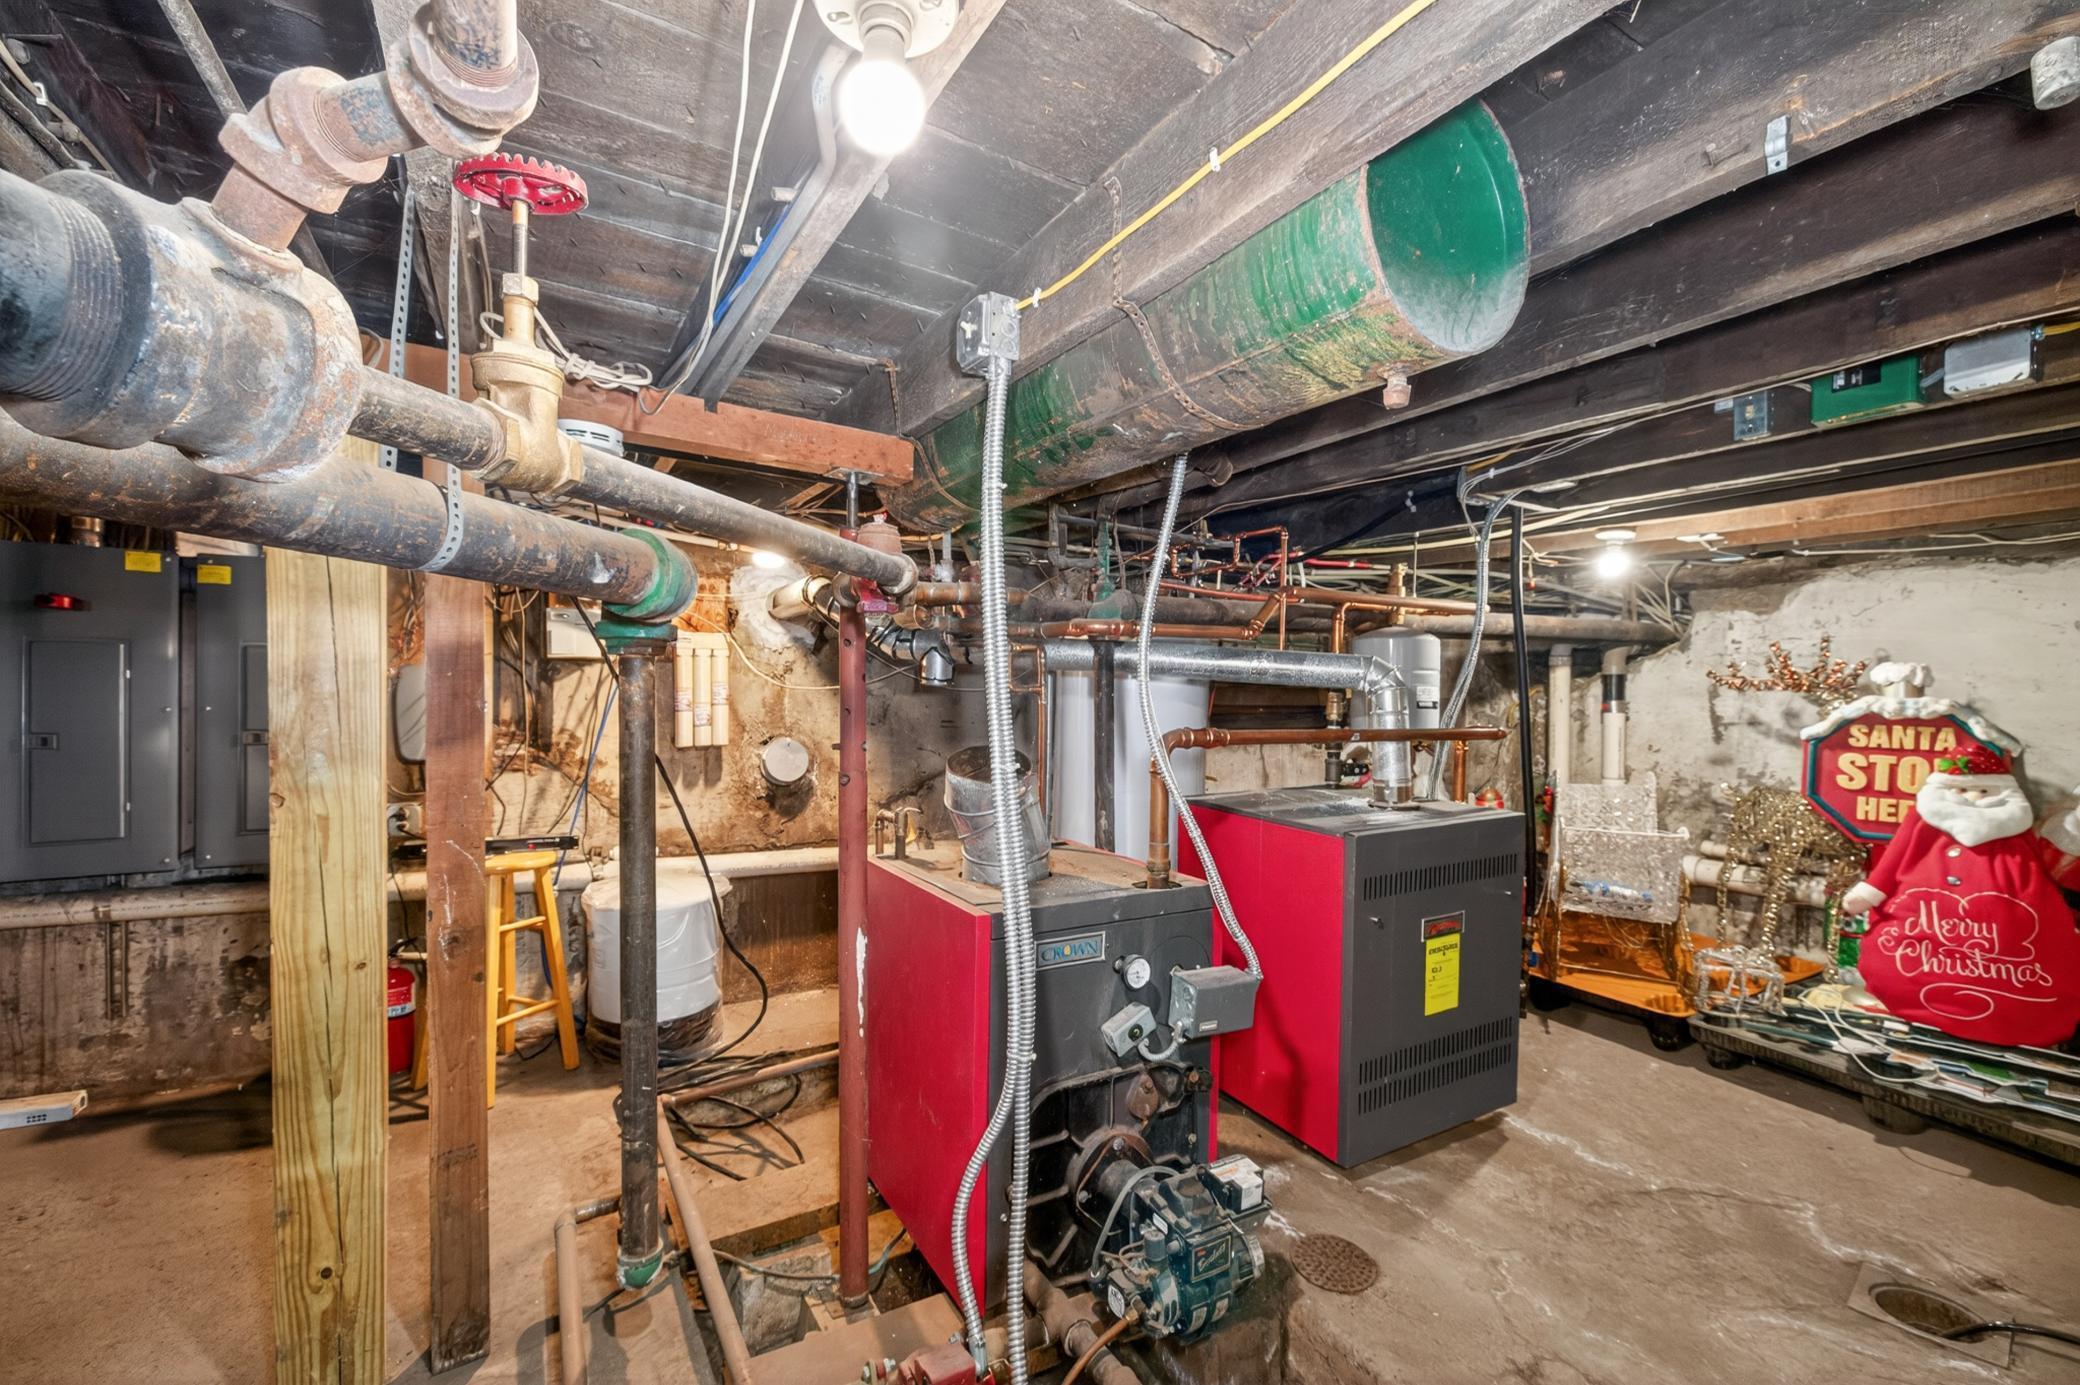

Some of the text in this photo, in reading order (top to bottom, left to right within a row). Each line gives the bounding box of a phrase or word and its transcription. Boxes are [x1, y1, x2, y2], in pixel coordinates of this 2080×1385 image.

[1848, 724, 1957, 751] SANTA
[1836, 752, 1945, 795] STO
[1856, 796, 1916, 823] HE
[1904, 900, 1999, 955] Merry
[1041, 940, 1099, 962] CROWN
[1895, 939, 2053, 988] Christmas
